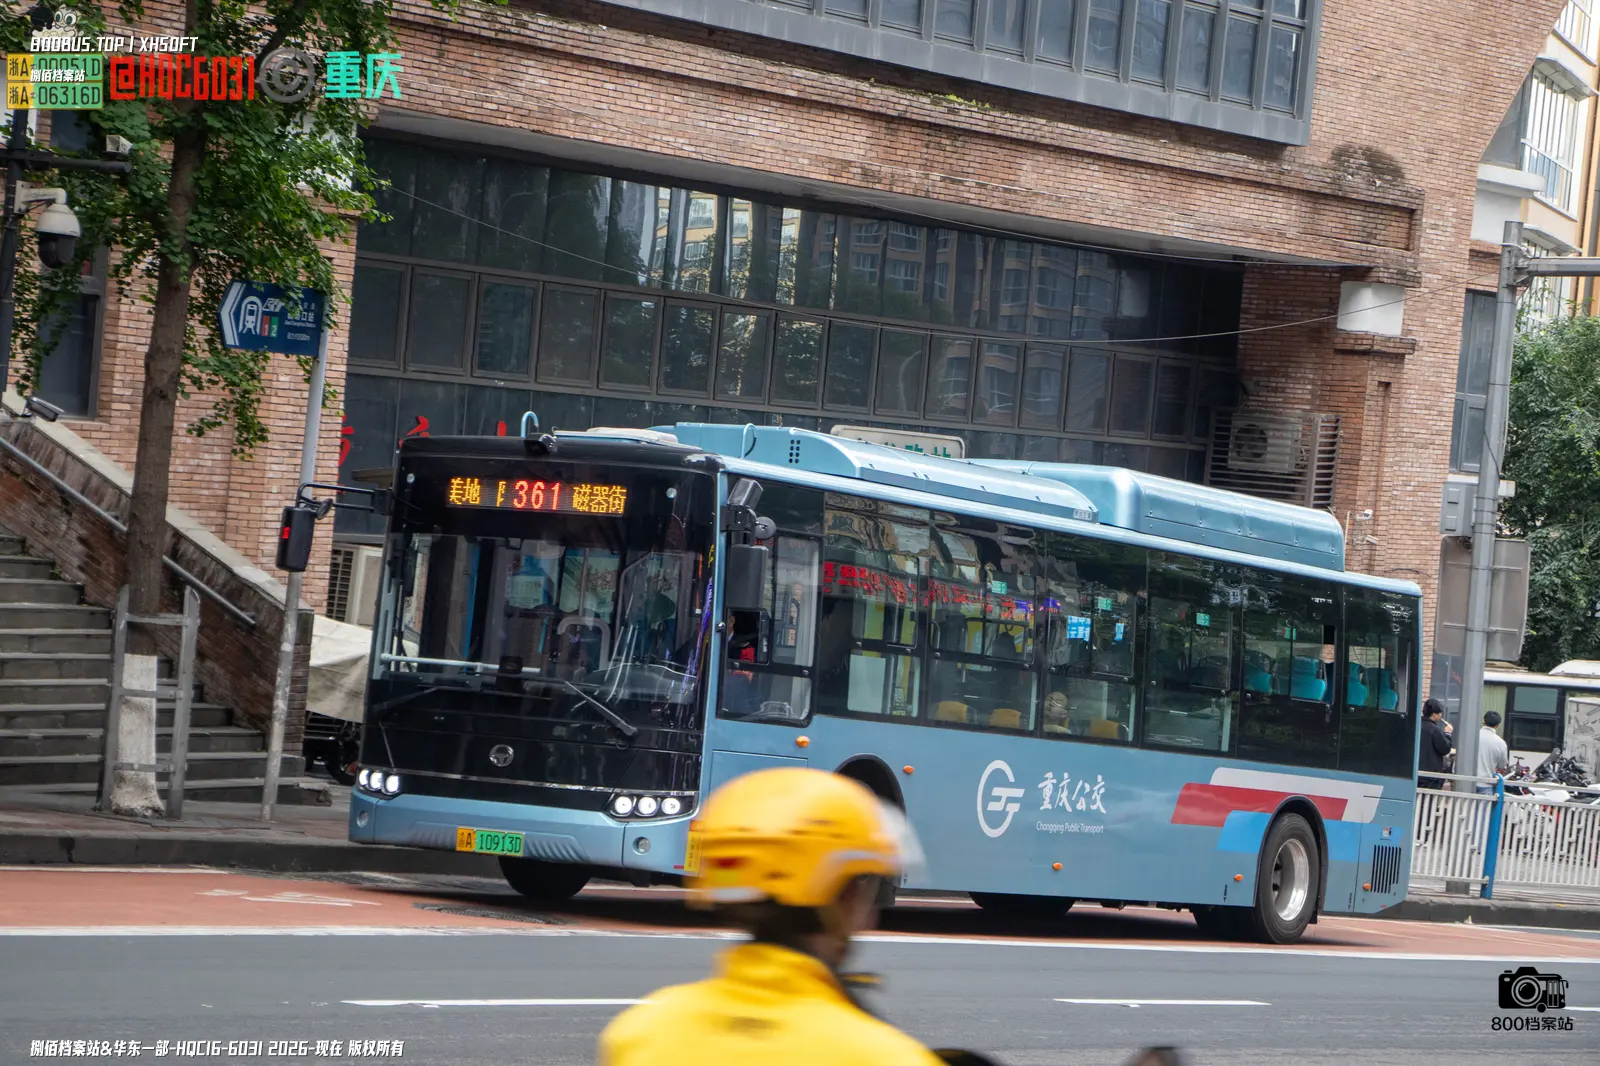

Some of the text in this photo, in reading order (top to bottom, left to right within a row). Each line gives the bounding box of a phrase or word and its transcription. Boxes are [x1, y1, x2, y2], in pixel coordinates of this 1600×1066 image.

[263, 324, 270, 336] 1
[271, 325, 278, 338] 2
[513, 480, 561, 510] 361
[1037, 771, 1107, 814] 重庆公交
[1065, 822, 1080, 833] Public
[1080, 823, 1104, 835] Transport
